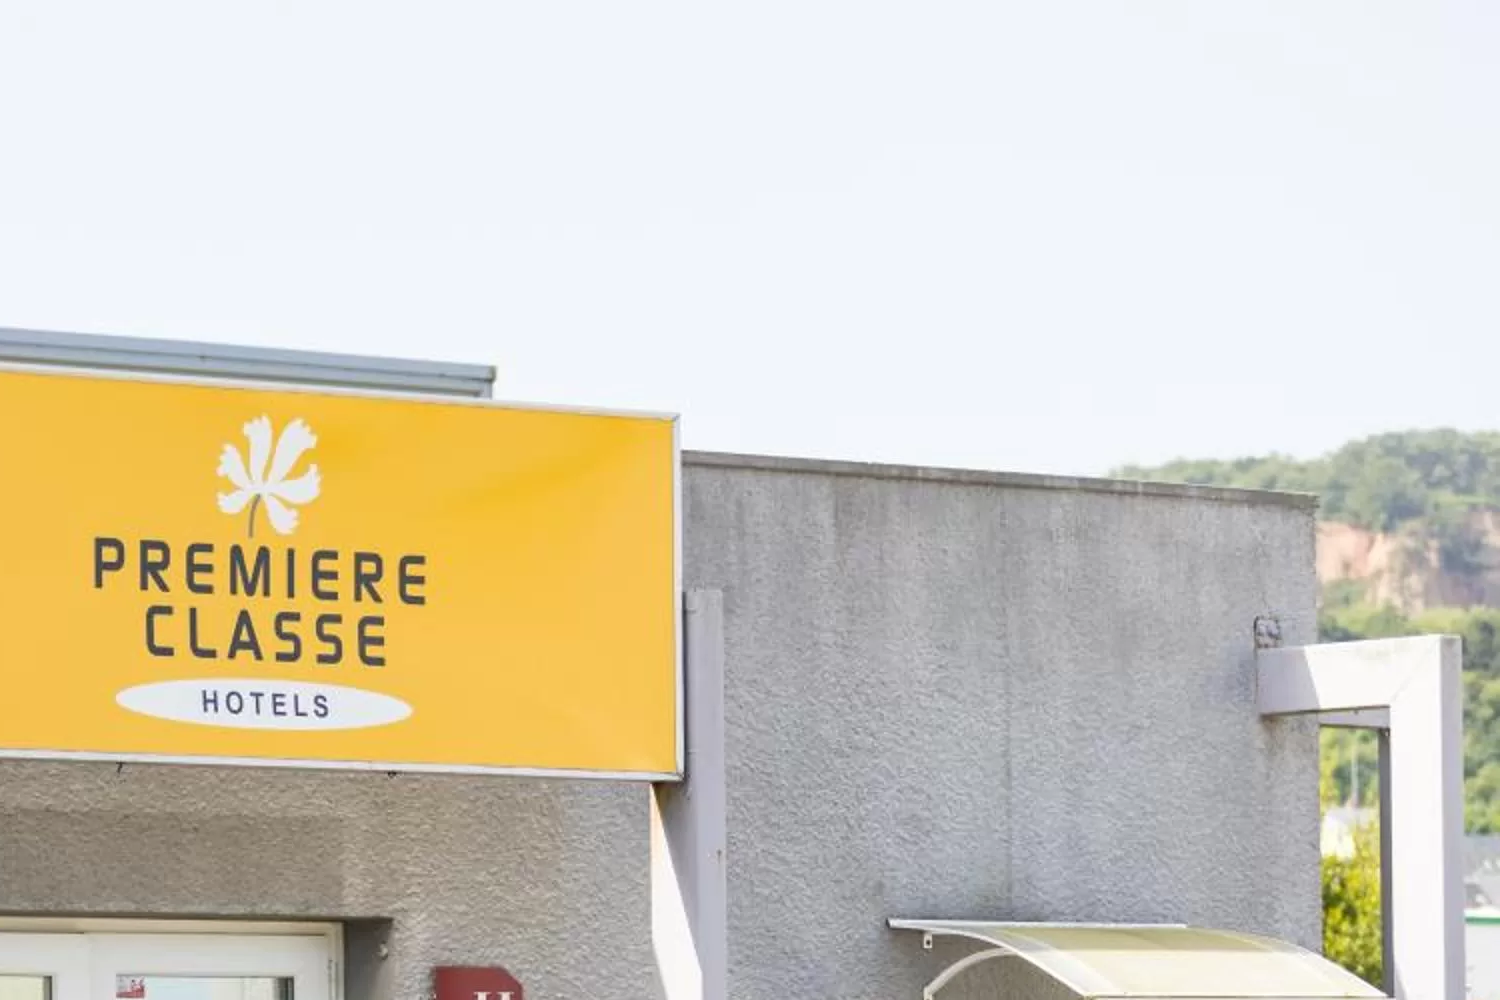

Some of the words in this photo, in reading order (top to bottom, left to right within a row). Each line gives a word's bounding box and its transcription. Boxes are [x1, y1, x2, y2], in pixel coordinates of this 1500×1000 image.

[93, 536, 427, 606] PREMIERE
[145, 604, 387, 667] CLASSE
[201, 689, 330, 718] HOTELS
